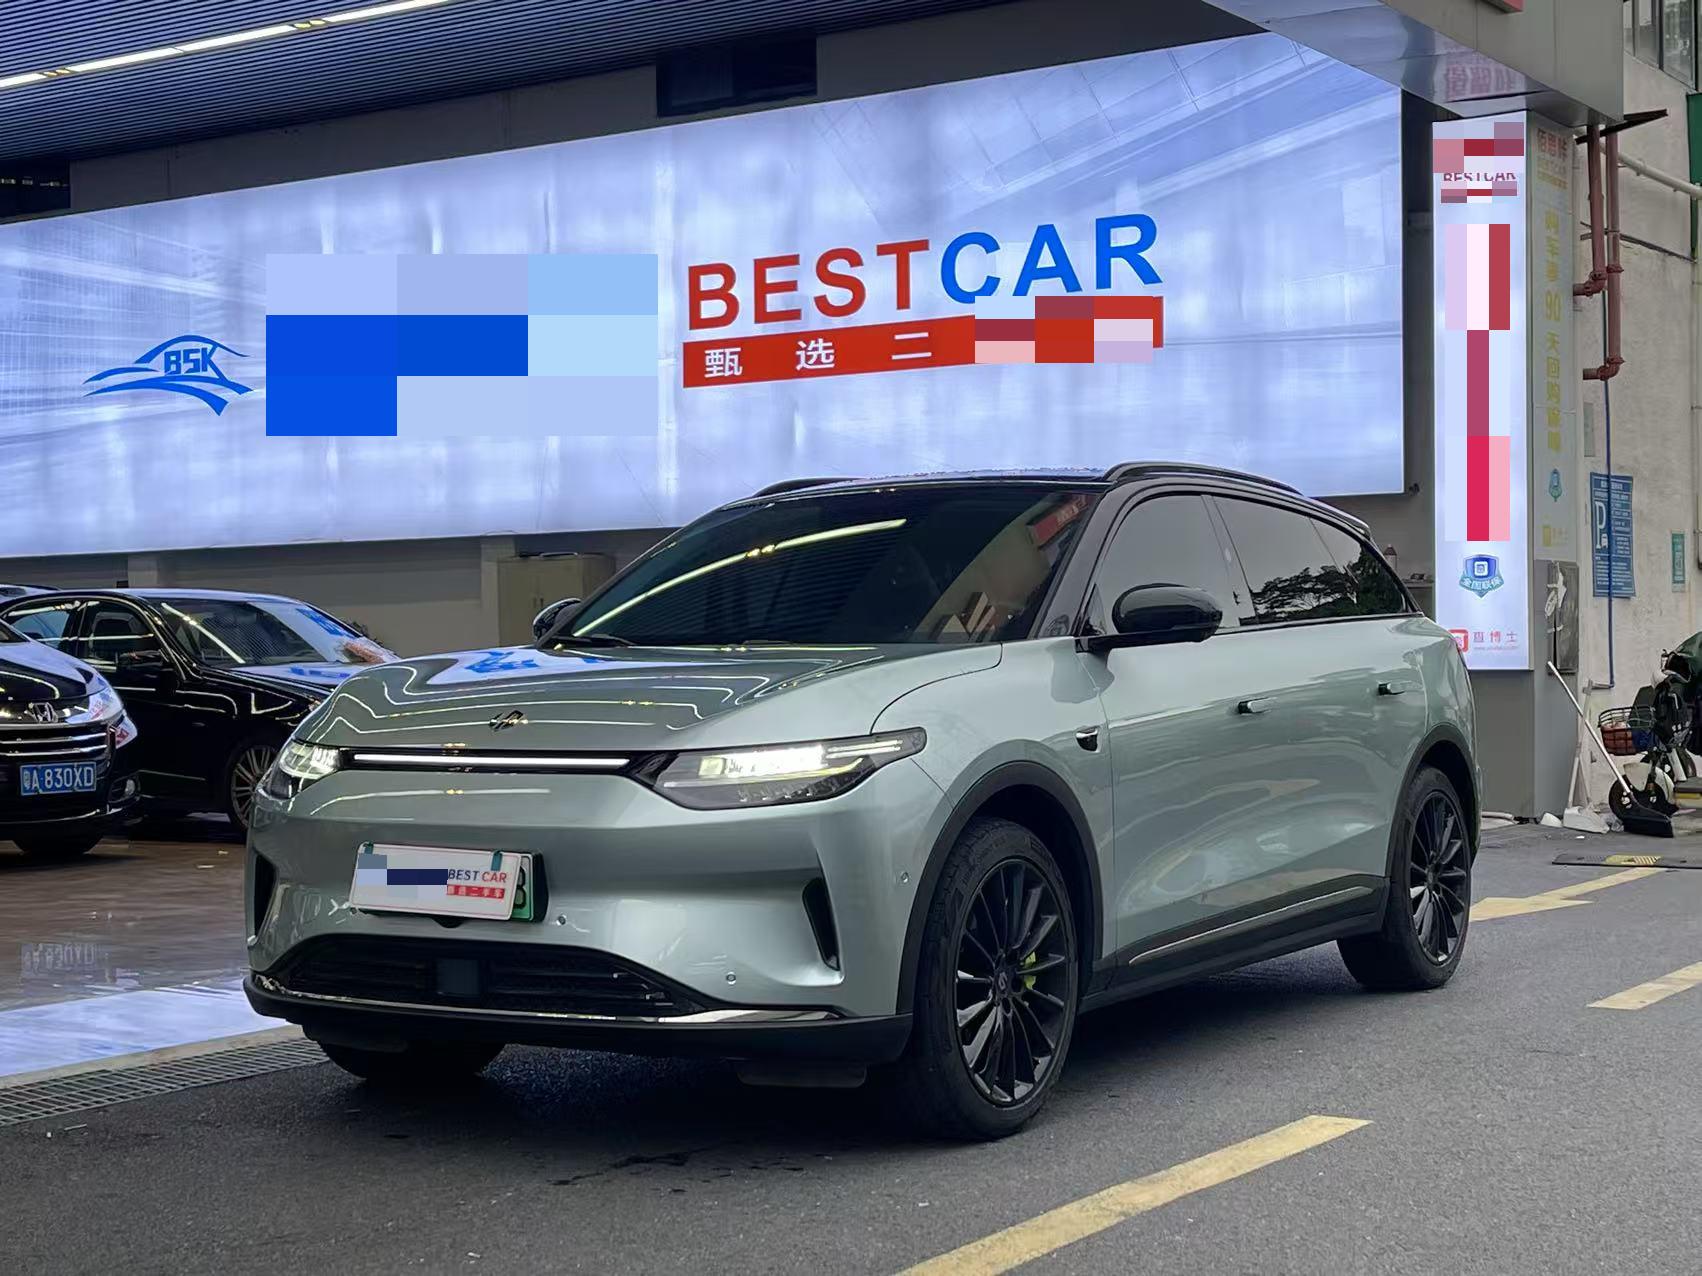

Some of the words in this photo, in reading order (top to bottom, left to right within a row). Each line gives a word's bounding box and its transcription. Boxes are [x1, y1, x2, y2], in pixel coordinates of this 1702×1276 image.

[164, 344, 224, 379] BSK
[704, 331, 932, 378] 甄选二
